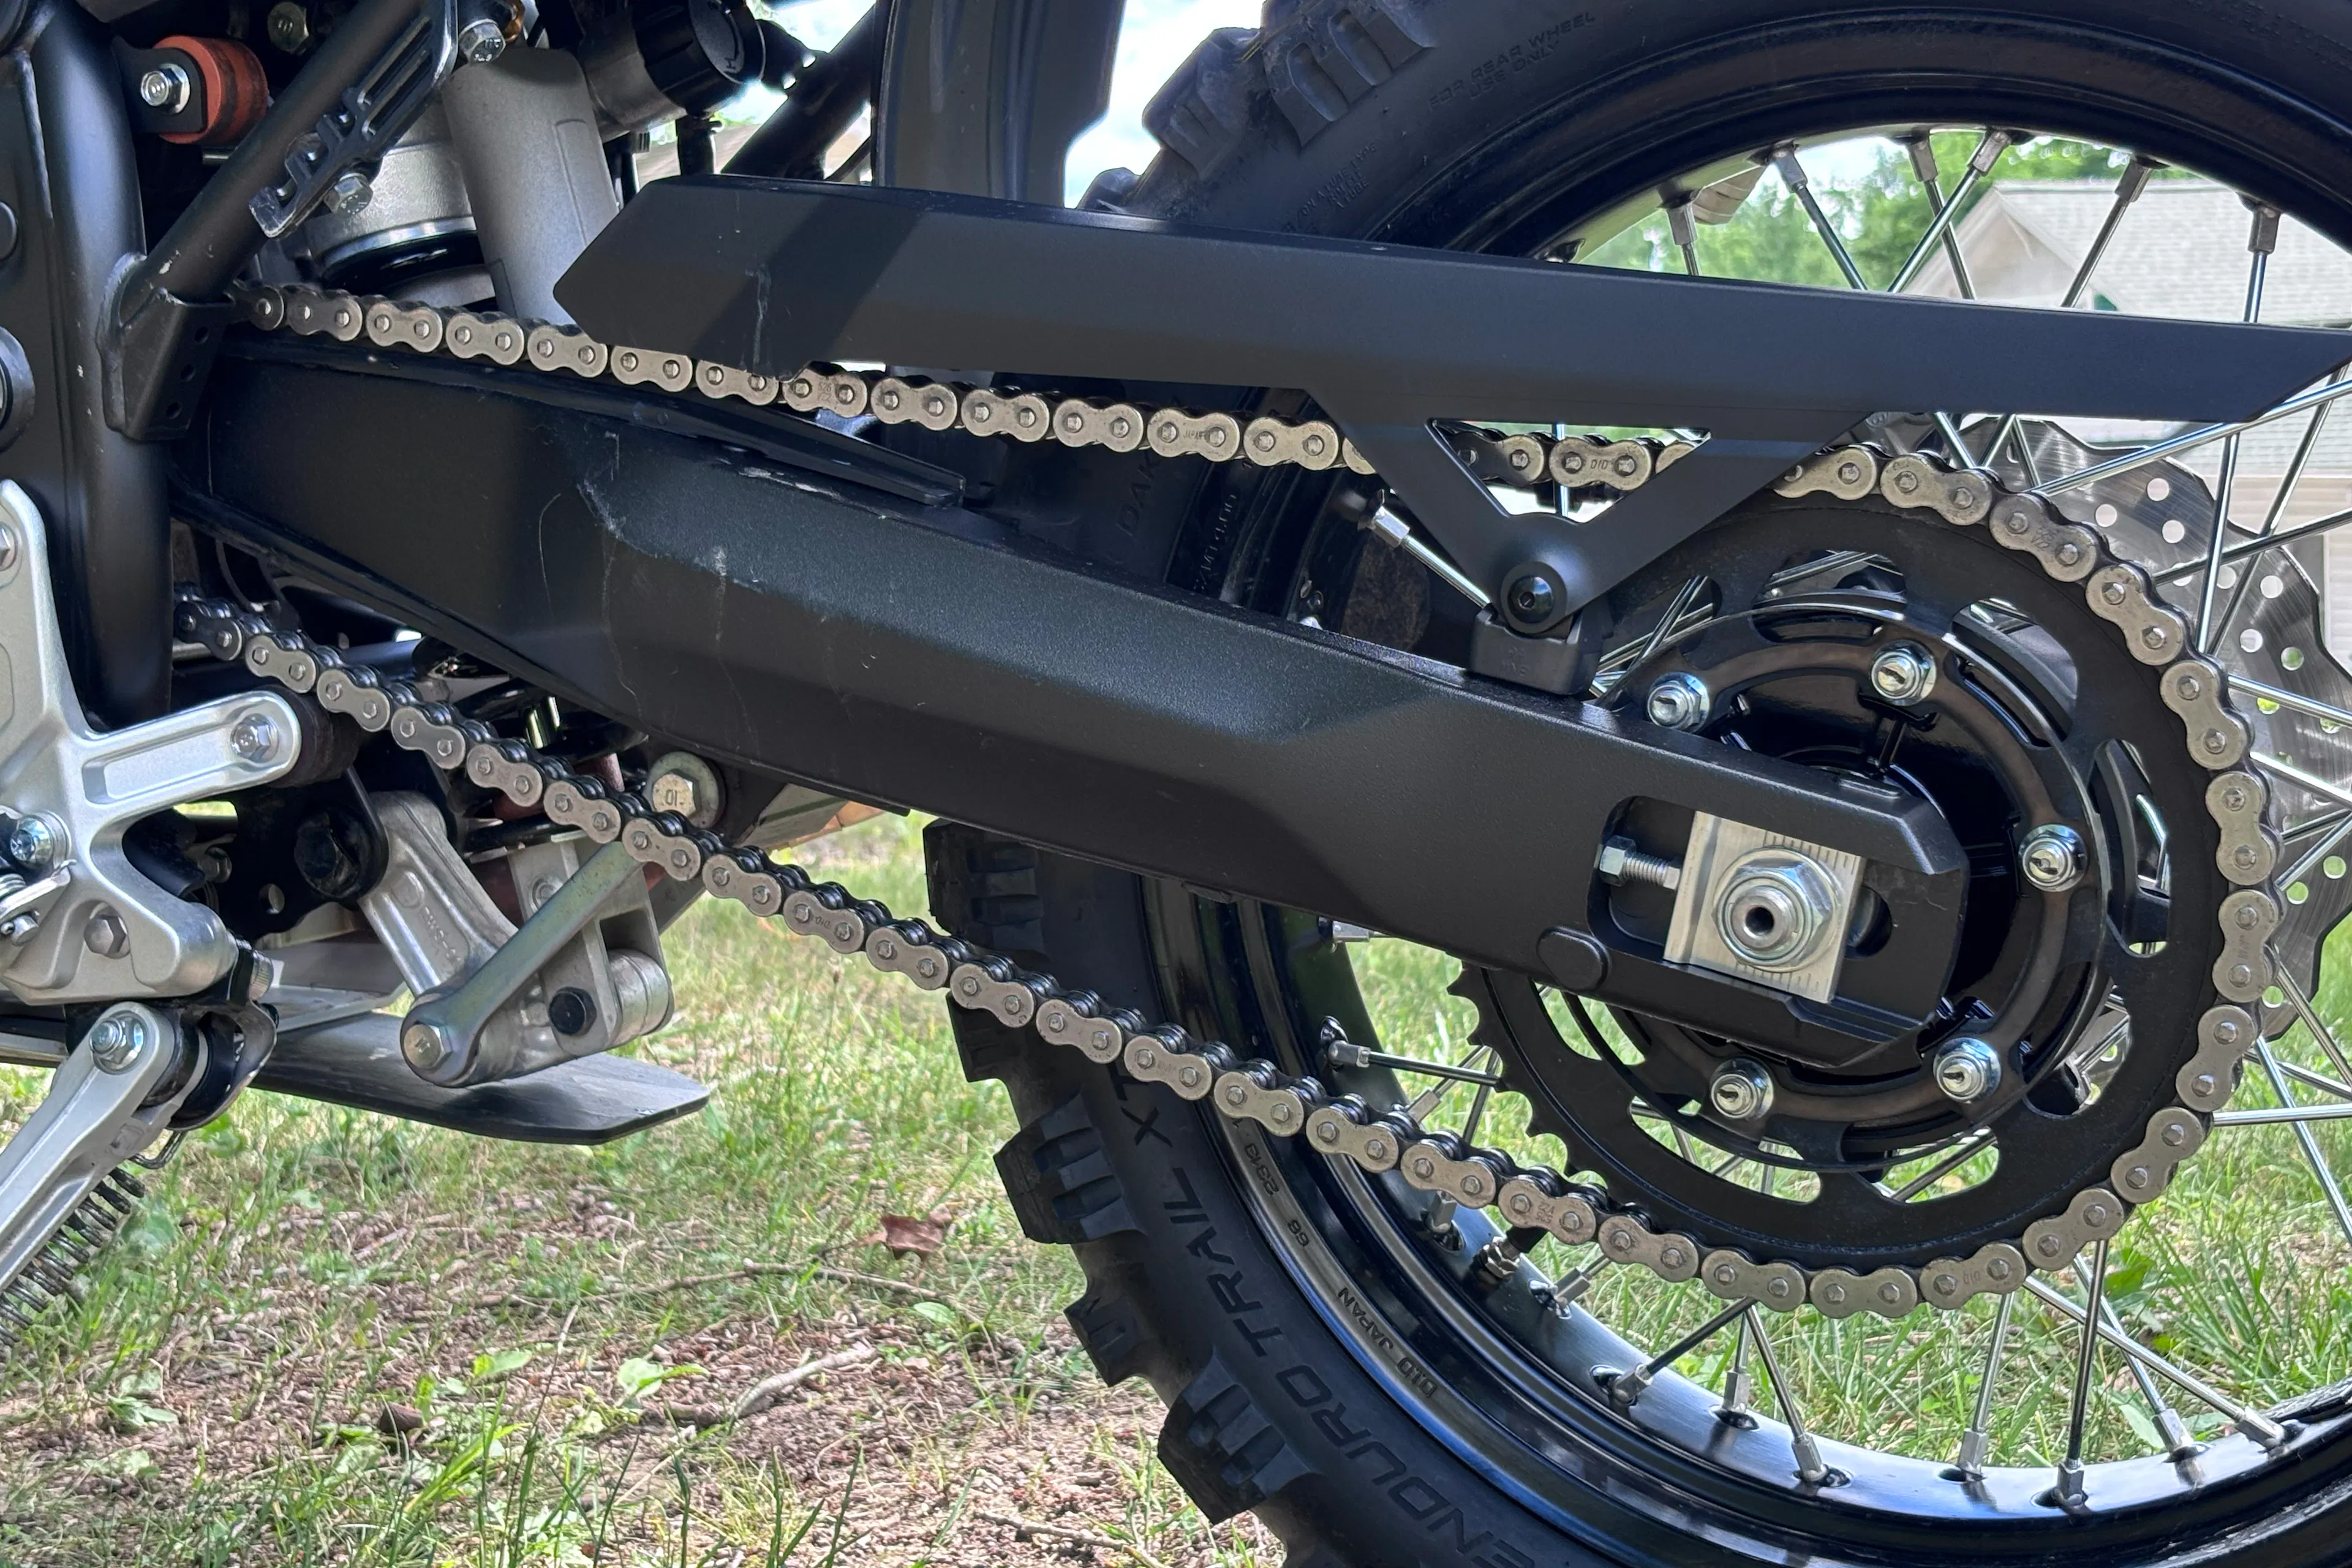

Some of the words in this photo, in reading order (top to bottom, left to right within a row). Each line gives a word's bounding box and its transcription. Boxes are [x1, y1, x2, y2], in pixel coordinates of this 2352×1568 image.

[1466, 43, 1525, 82] REAR
[1526, 7, 1597, 52] WHEEL
[1466, 67, 1508, 100] USE
[1508, 39, 1564, 75] ONLY
[1242, 1142, 1281, 1197] 2313
[1164, 1167, 1282, 1357] TRAIL
[1335, 1286, 1394, 1354] JAPAN
[1276, 1363, 1535, 1568] ENDURO
